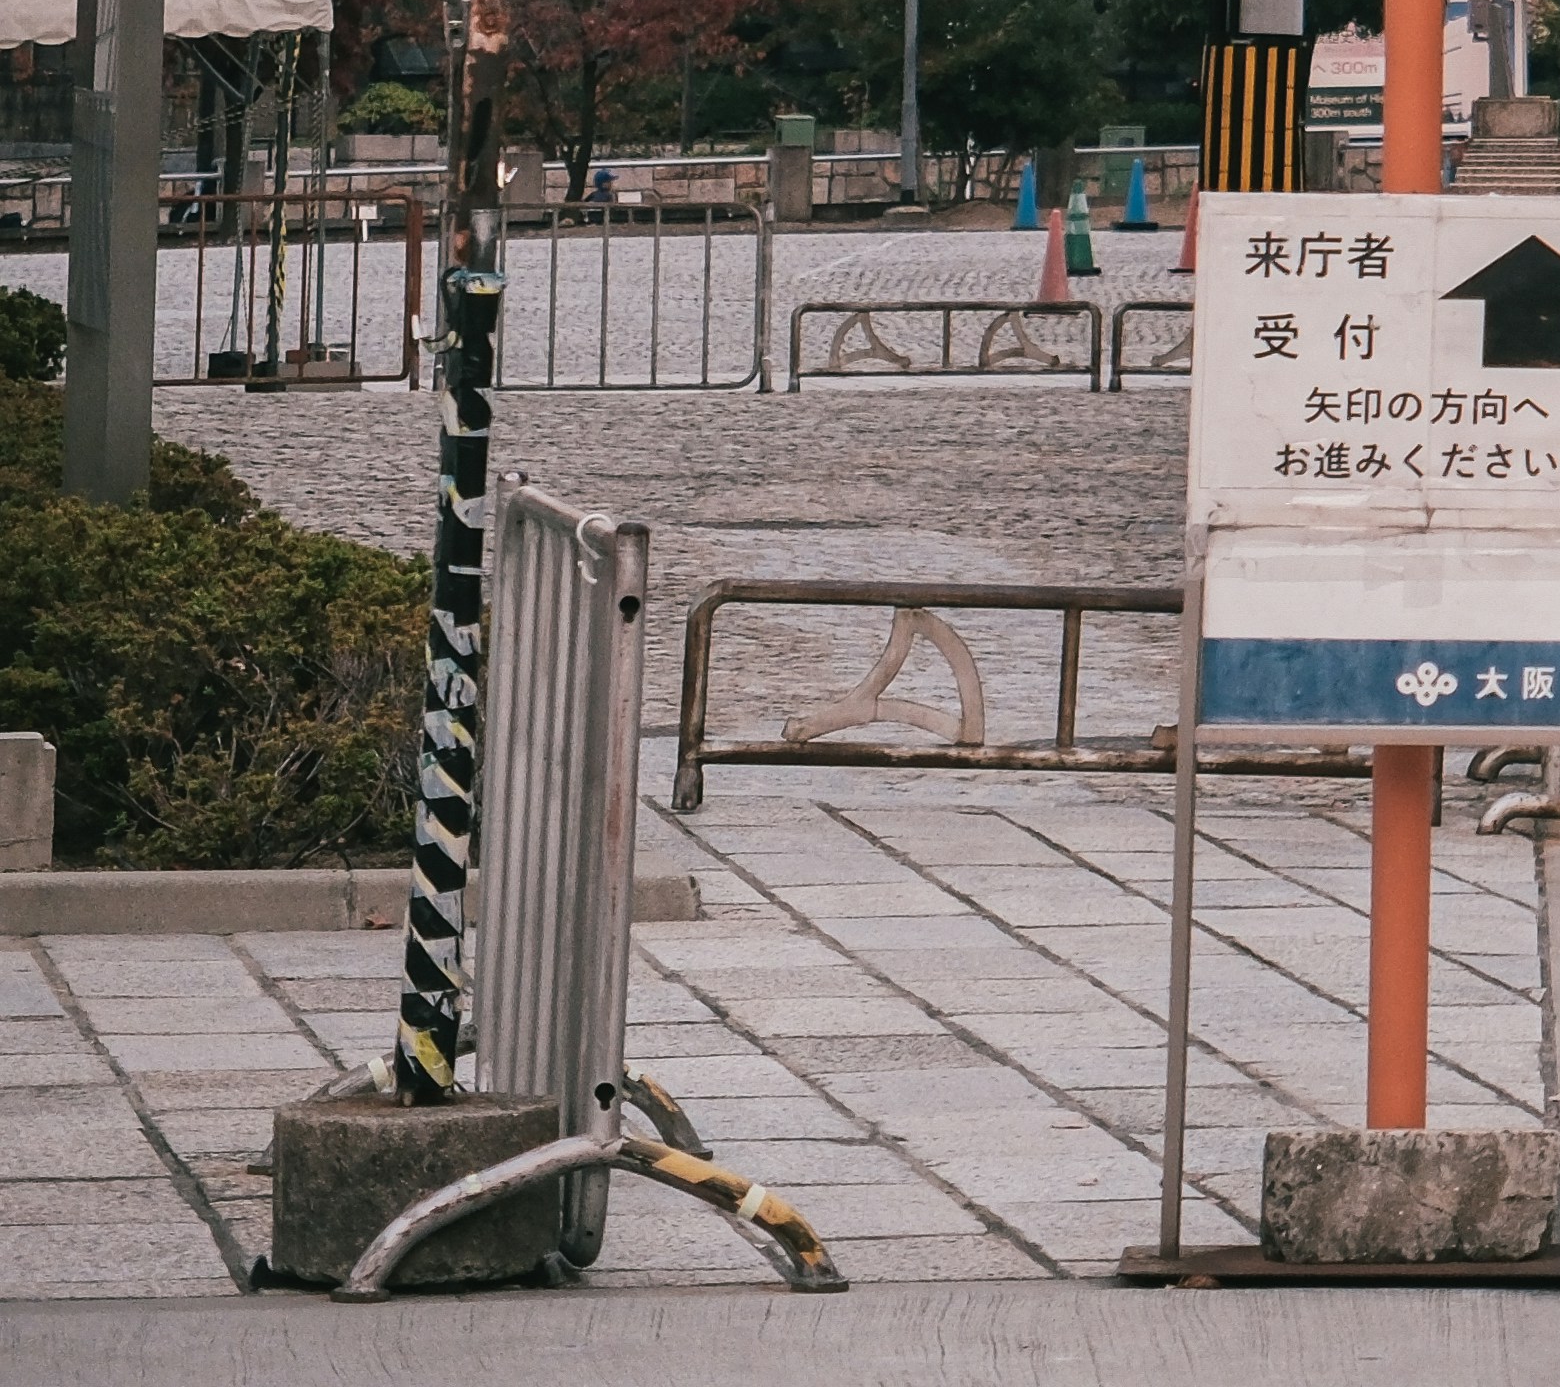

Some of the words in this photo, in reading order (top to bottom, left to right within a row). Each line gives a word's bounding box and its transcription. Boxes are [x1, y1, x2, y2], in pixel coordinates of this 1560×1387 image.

[1245, 231, 1394, 279] 来庁者
[1253, 313, 1380, 361] 受付
[1304, 386, 1549, 425] 矢印の方向へ
